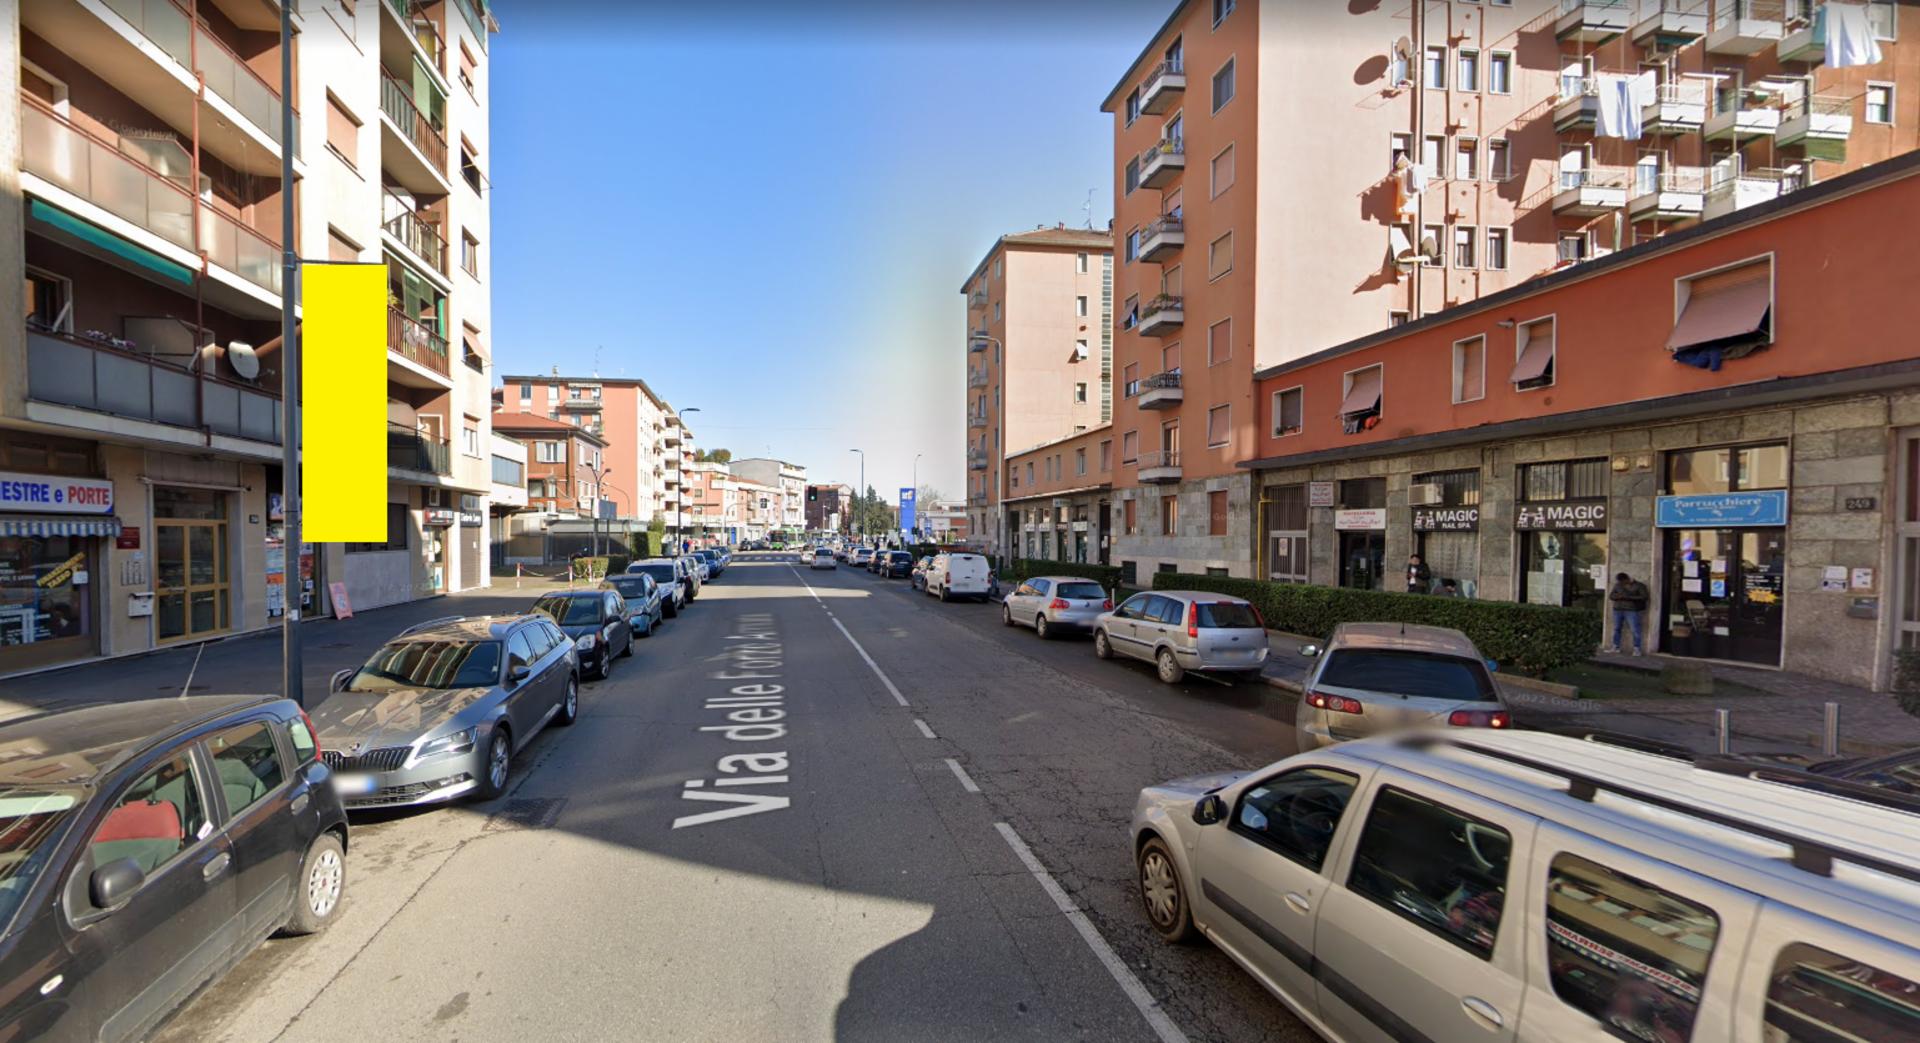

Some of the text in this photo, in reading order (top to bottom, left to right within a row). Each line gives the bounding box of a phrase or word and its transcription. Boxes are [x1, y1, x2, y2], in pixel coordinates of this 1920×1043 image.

[54, 488, 64, 503] e
[68, 485, 111, 505] PORTE
[1674, 497, 1763, 509] Parrucchiere
[1847, 499, 1871, 510] 249
[1435, 509, 1478, 522] MAGIC
[1547, 505, 1605, 520] MAGIC
[1555, 520, 1595, 529] NAIL SPA
